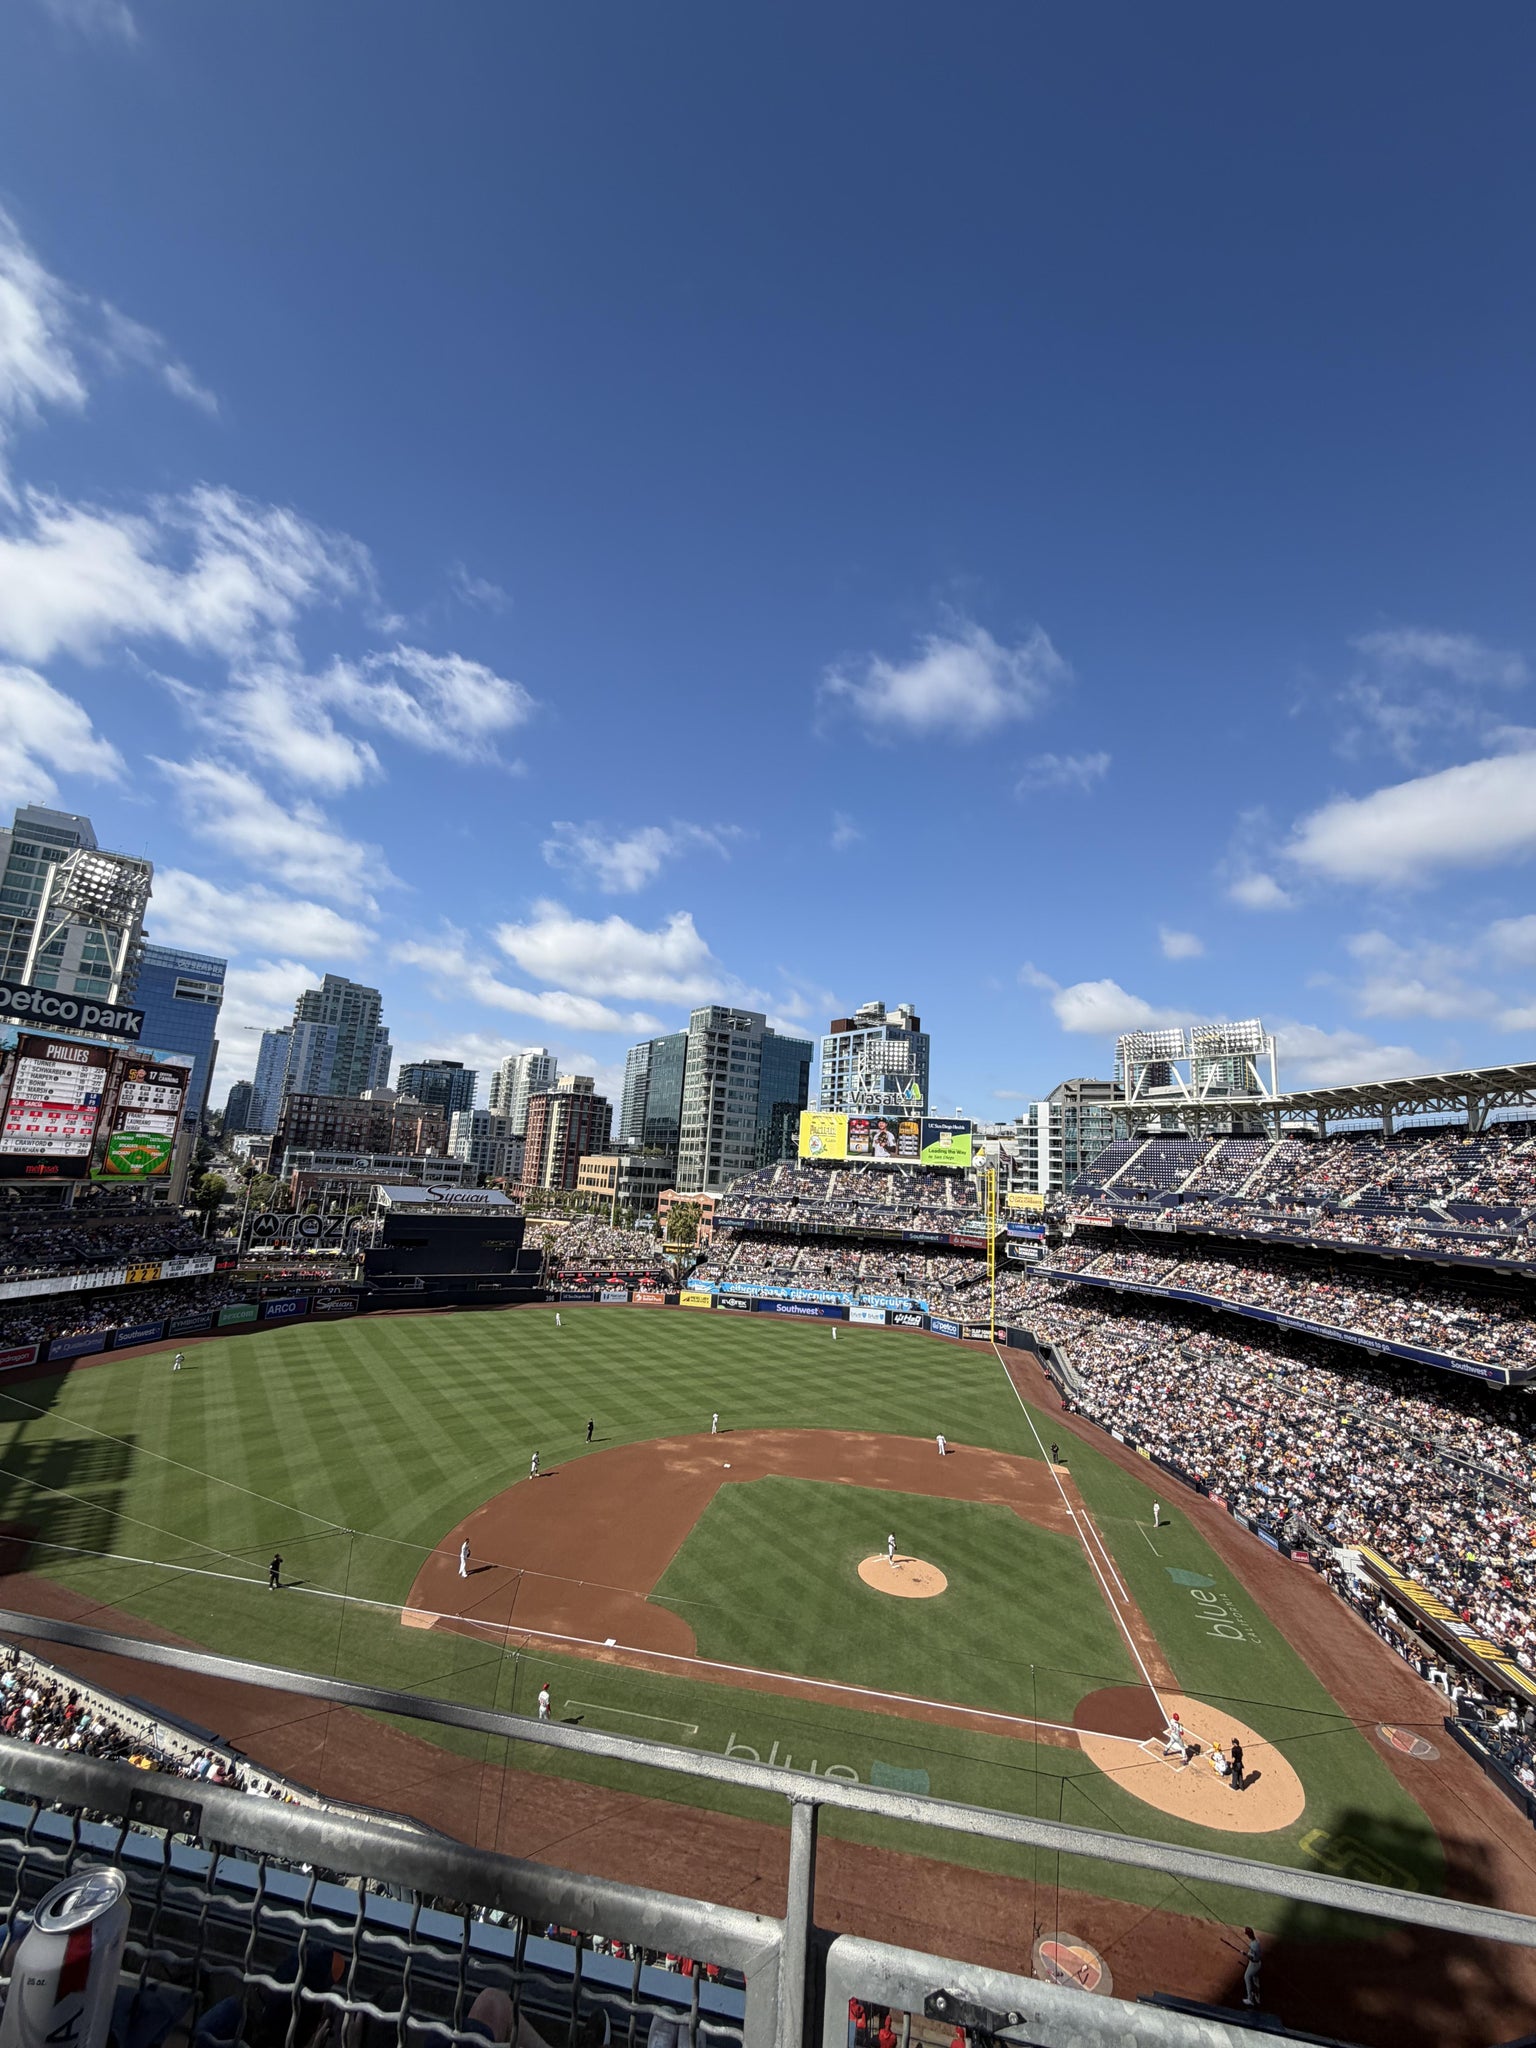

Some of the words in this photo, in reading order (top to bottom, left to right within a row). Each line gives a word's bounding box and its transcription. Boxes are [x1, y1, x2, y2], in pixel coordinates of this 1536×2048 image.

[79, 1004, 142, 1033] park
[46, 1044, 90, 1063] PHILLIES
[32, 1066, 66, 1076] SCHWARBER
[34, 1060, 56, 1068] TURNER
[30, 1073, 53, 1081] HARPER
[149, 1071, 157, 1080] 17
[27, 1086, 48, 1094] MARSH
[851, 1091, 899, 1105] Viasat
[15, 1139, 47, 1147] CRAWFORD
[928, 1148, 948, 1156] Leading
[425, 1184, 491, 1206] Sycuan
[280, 1214, 365, 1238] razr
[718, 1218, 745, 1226] Southwest
[909, 1233, 939, 1242] Southwest
[130, 1271, 136, 1282] 2
[142, 1270, 147, 1281] 2
[152, 1269, 158, 1279] 2
[267, 1302, 296, 1315] ARCO
[316, 1296, 354, 1311] Sycuan
[776, 1303, 819, 1316] Southwest
[939, 1322, 957, 1333] petco
[1276, 1316, 1288, 1324] More
[1288, 1319, 1306, 1329] comfort,
[1306, 1324, 1319, 1332] more
[1319, 1326, 1343, 1340] reliability,
[1343, 1334, 1357, 1342] more
[1357, 1337, 1374, 1348] places
[1381, 1344, 1391, 1352] go.
[118, 1328, 155, 1342] Southwest
[1450, 1360, 1488, 1376] Southwest
[1388, 1577, 1465, 1623] FAITHFUL
[1190, 1589, 1247, 1642] blue
[1219, 1593, 1262, 1644] CALIFORNIA
[1440, 1619, 1481, 1638] THE
[1458, 1636, 1515, 1664] FOR
